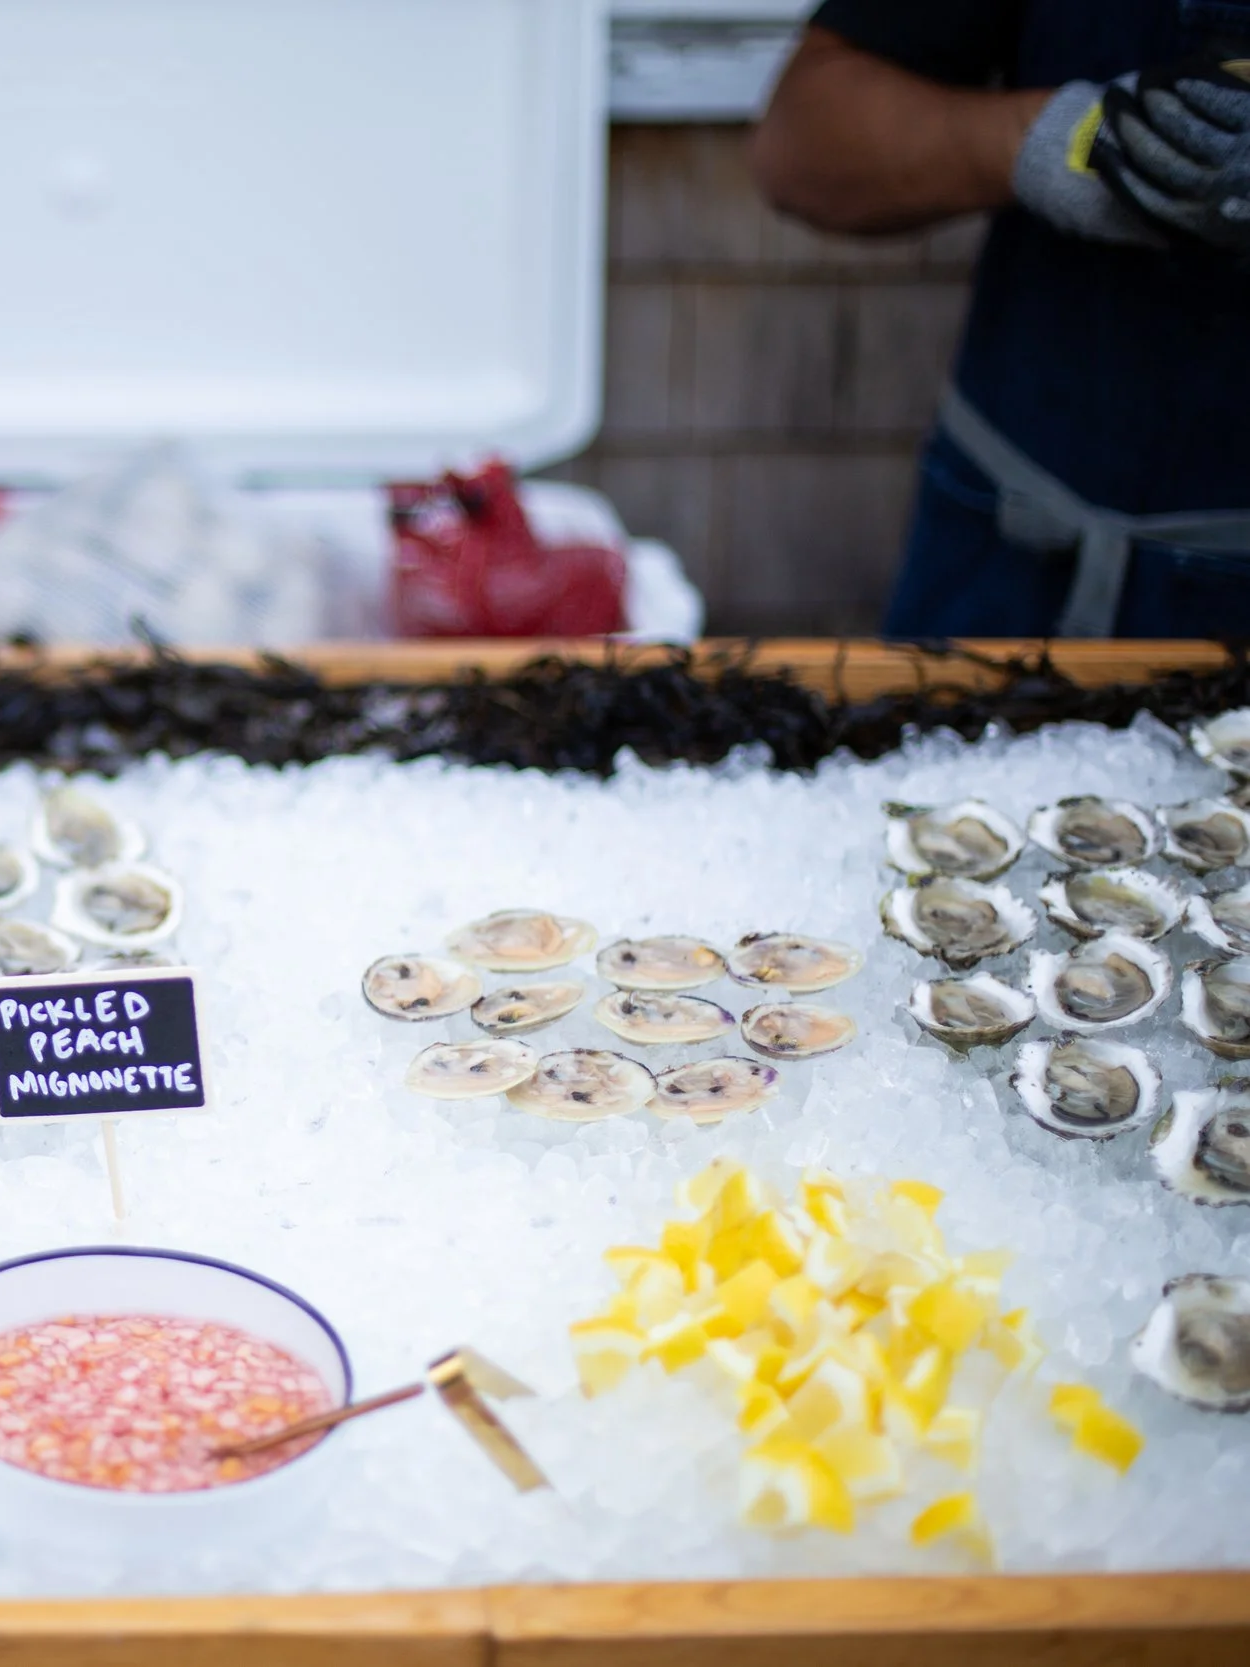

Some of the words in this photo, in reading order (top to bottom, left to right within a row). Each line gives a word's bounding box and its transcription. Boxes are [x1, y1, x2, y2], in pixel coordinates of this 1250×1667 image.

[0, 990, 150, 1030] PICKLED
[29, 1025, 145, 1063] PEACH
[9, 1062, 197, 1101] MIGNONETTE
